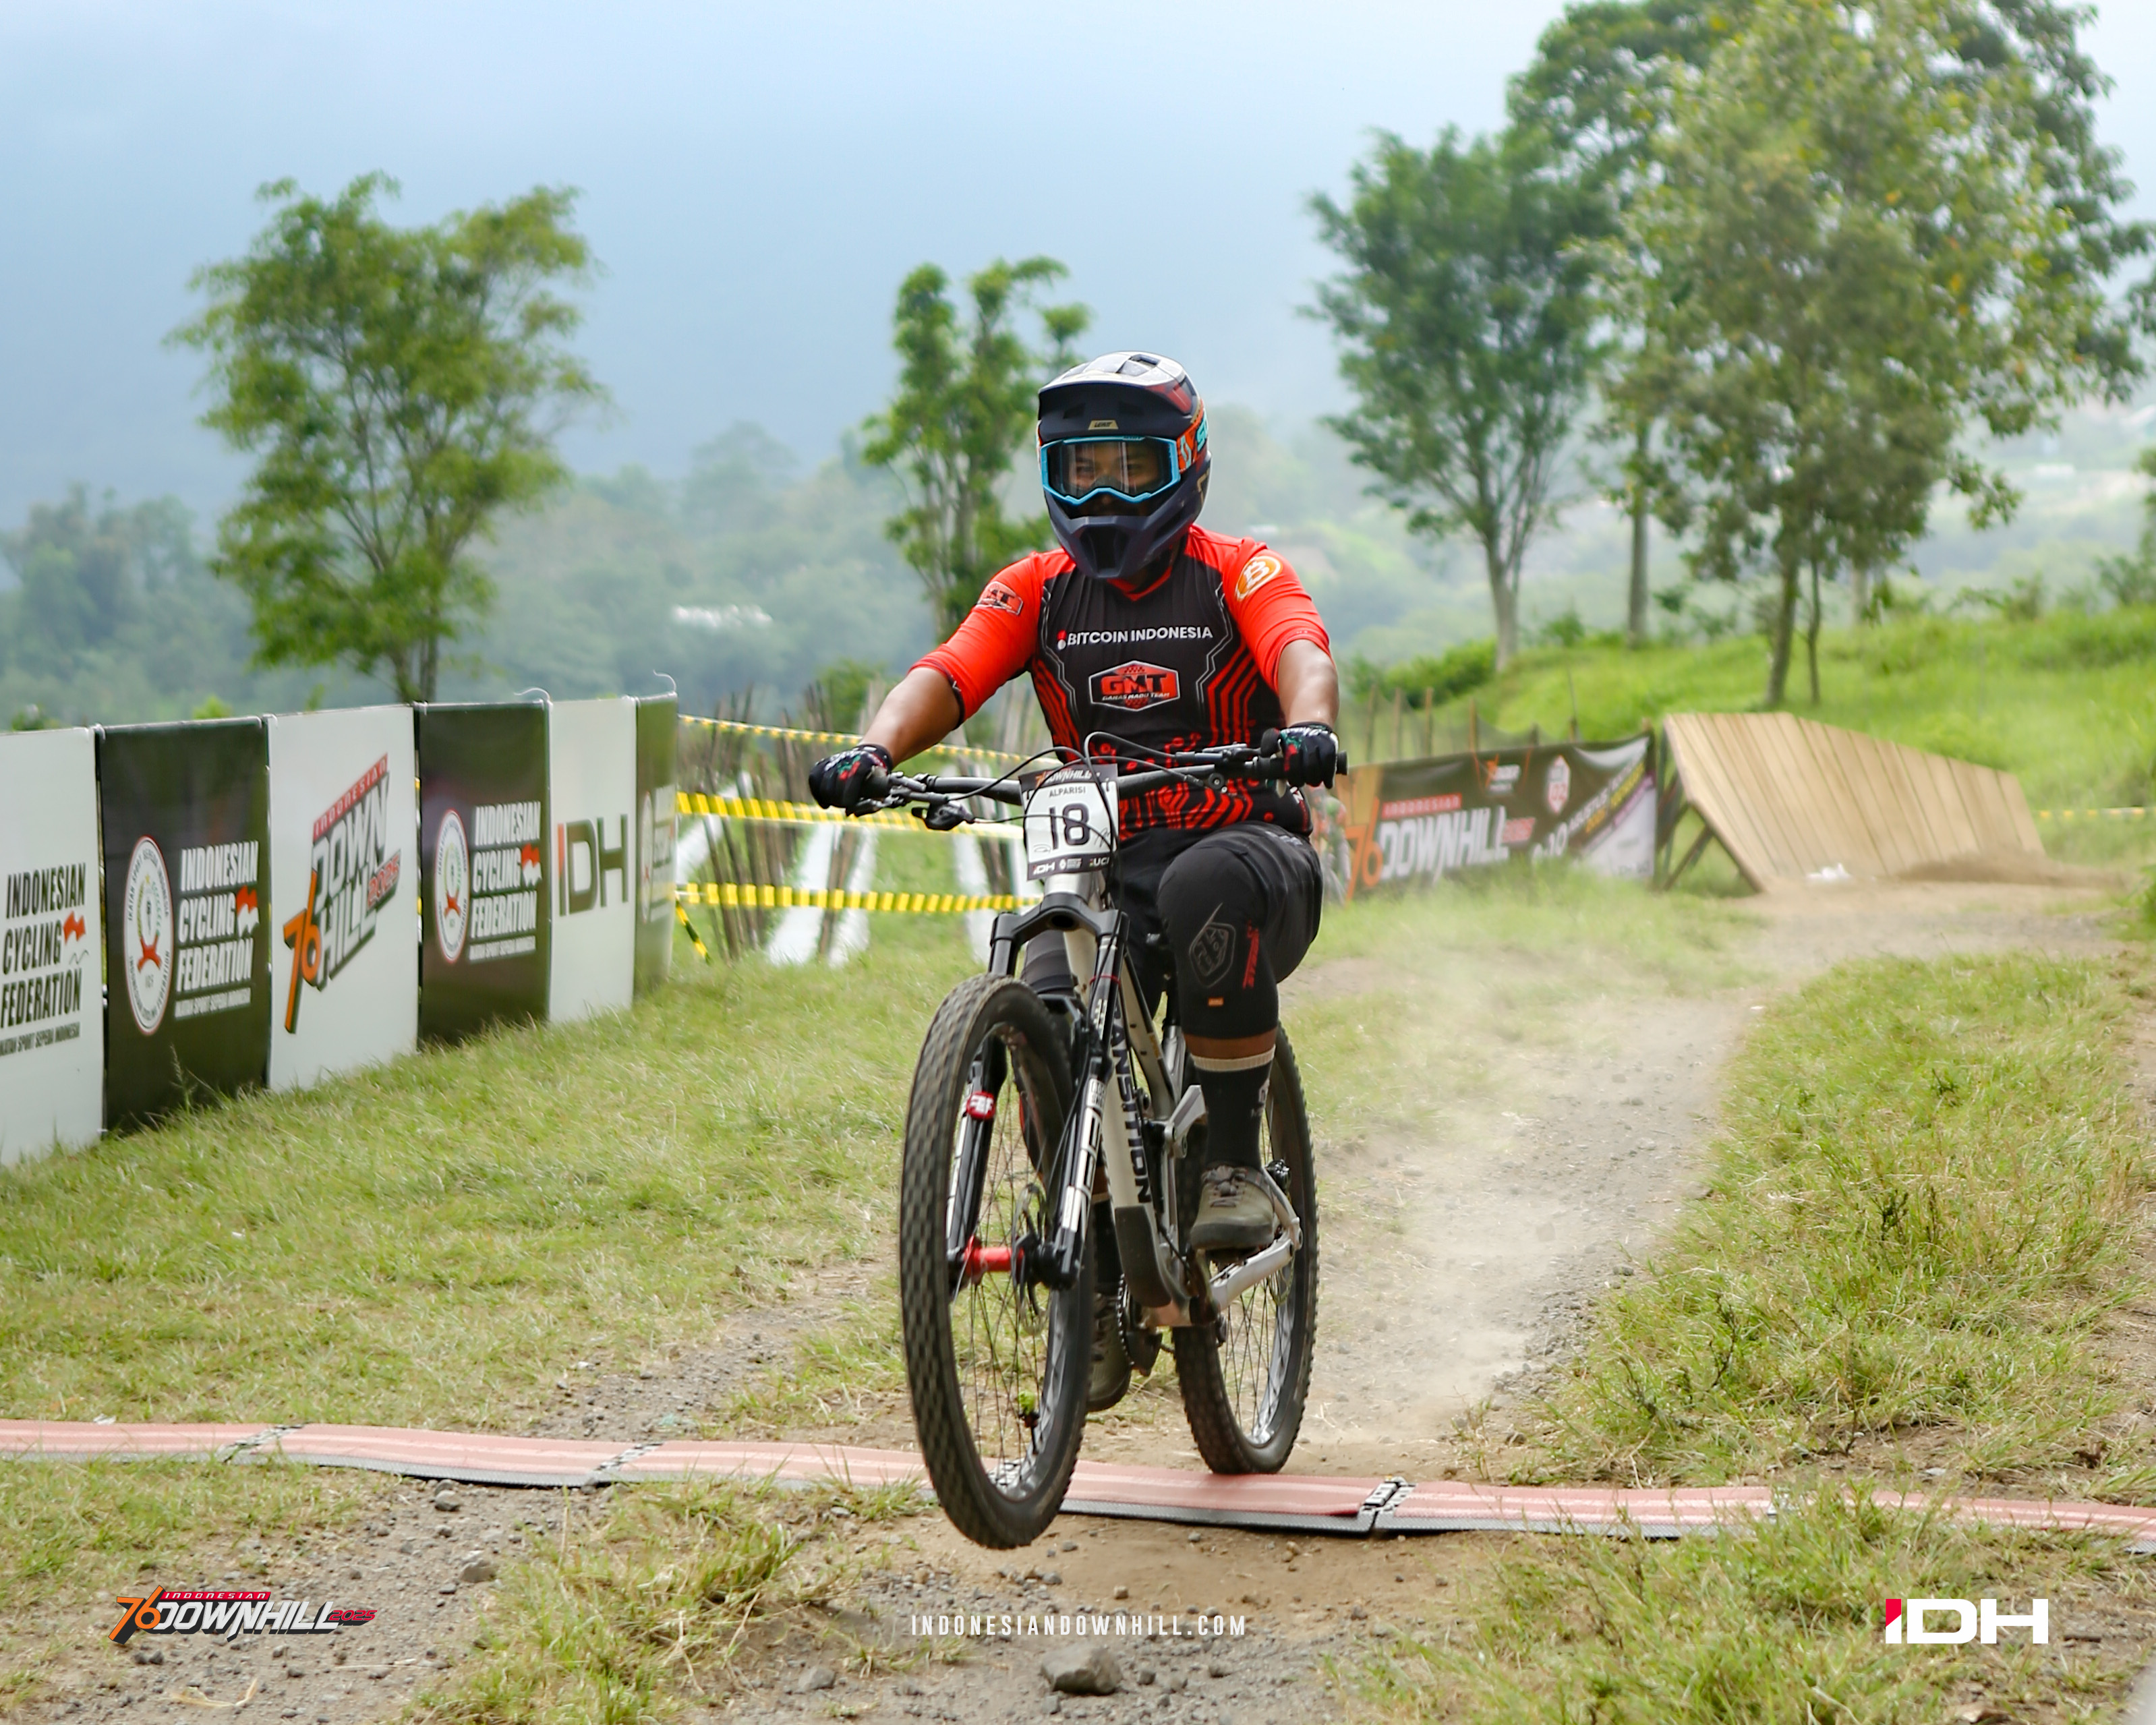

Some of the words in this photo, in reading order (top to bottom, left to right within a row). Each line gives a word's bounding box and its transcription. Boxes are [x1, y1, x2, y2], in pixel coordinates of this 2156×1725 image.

[1067, 630, 1129, 646] BITCOIN
[1130, 626, 1214, 641] INDONESIA
[1101, 674, 1167, 695] GMT
[314, 758, 386, 837] INDONESIAN
[1049, 787, 1086, 798] ALPARISI
[312, 773, 388, 915] DOWN
[475, 801, 542, 846] INDONESIAN
[1049, 802, 1090, 850] 18
[1345, 796, 1382, 901] 76
[1380, 805, 1509, 881] DOWNHILL
[181, 840, 259, 891] INDONESIAN
[368, 853, 401, 908] 2025
[473, 847, 522, 893] CYCLING
[557, 813, 629, 918] IDH
[1093, 856, 1110, 867] UCI
[6, 862, 86, 919] INDONESIAN
[178, 892, 237, 943] CYCLING
[471, 890, 537, 939] FEDERATION
[3, 919, 62, 975] CYCLING
[176, 937, 254, 992] FEDERATION
[283, 871, 322, 1034] 76
[0, 968, 82, 1029] FEDERATION
[1111, 995, 1152, 1203] ANSITION
